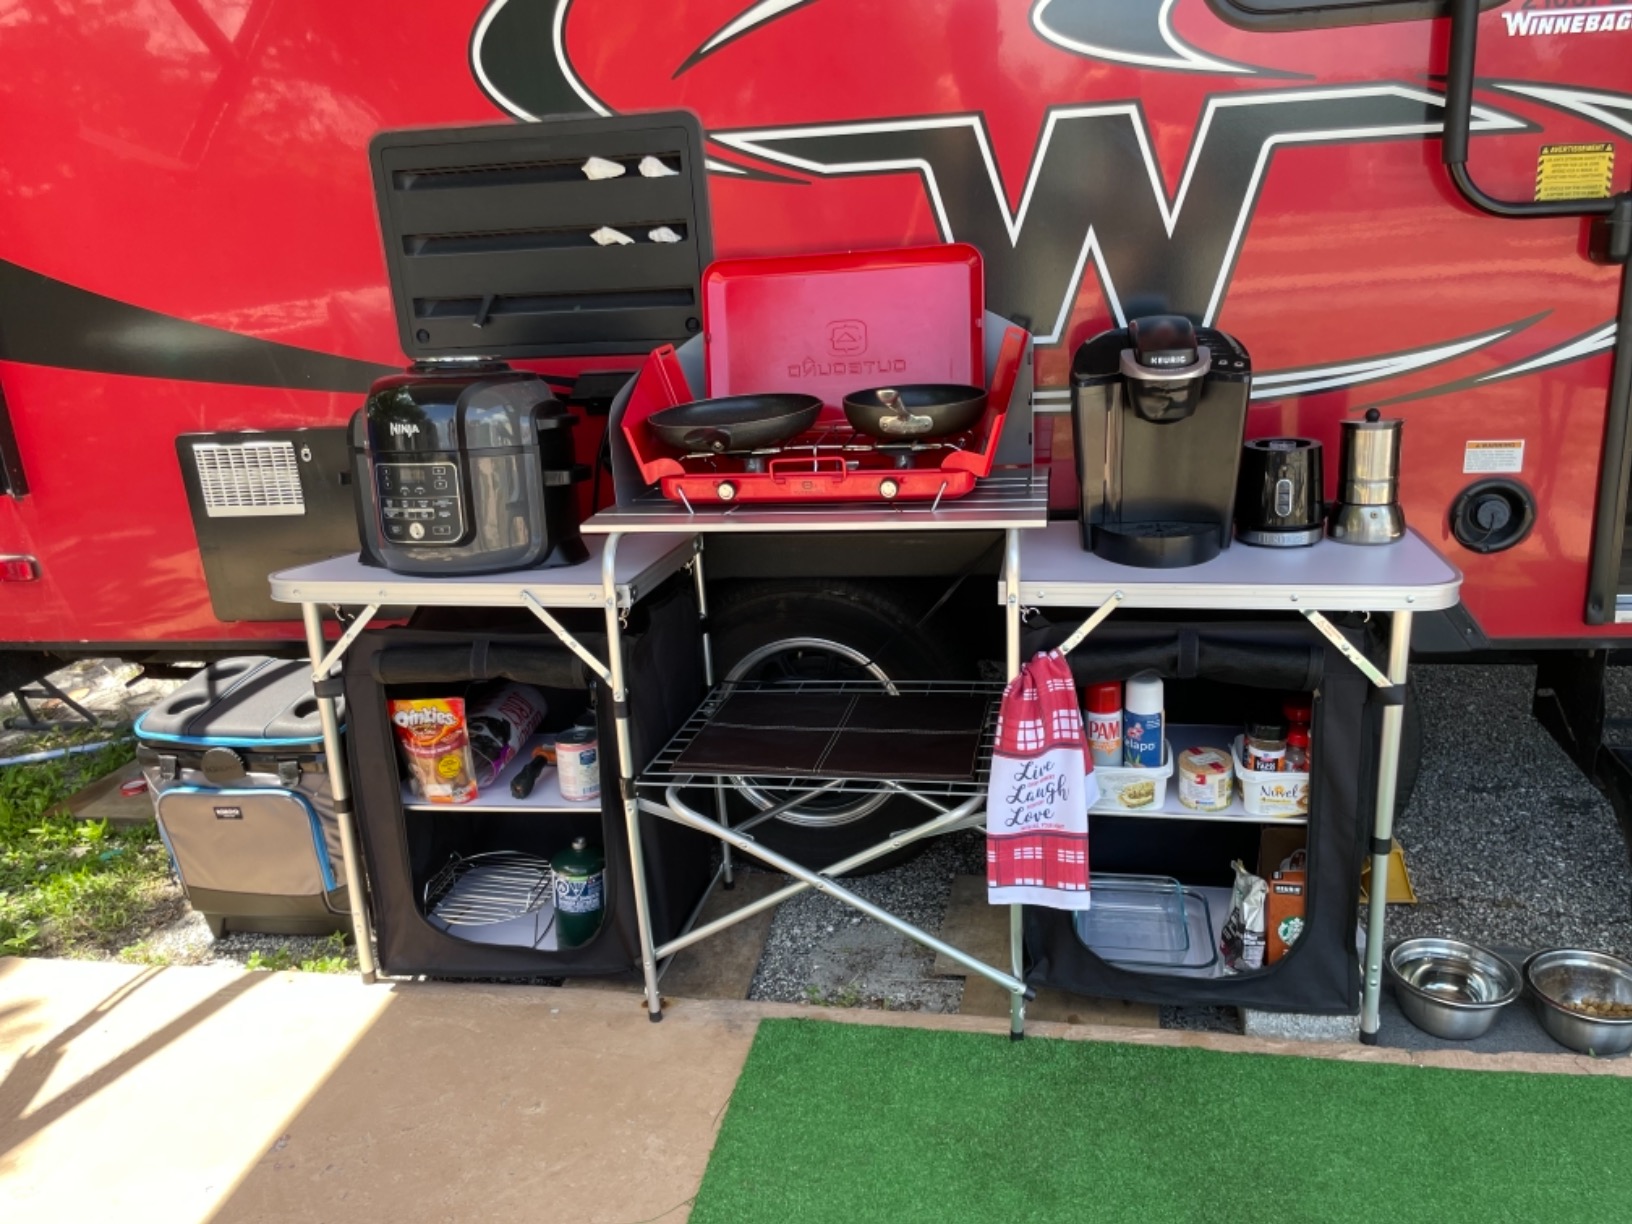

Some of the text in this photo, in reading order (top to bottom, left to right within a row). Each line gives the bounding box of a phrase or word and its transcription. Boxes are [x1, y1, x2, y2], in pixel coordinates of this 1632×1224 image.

[1502, 9, 1632, 36] WINNEBAG
[1150, 356, 1186, 364] KEURIG
[390, 422, 420, 438] NINJA
[394, 707, 455, 727] Oinkies
[1089, 721, 1120, 740] PAM
[1014, 761, 1055, 782] Live
[1006, 774, 1070, 804] Laugh
[1260, 784, 1299, 798] Nuvel
[1005, 807, 1055, 827] Love
